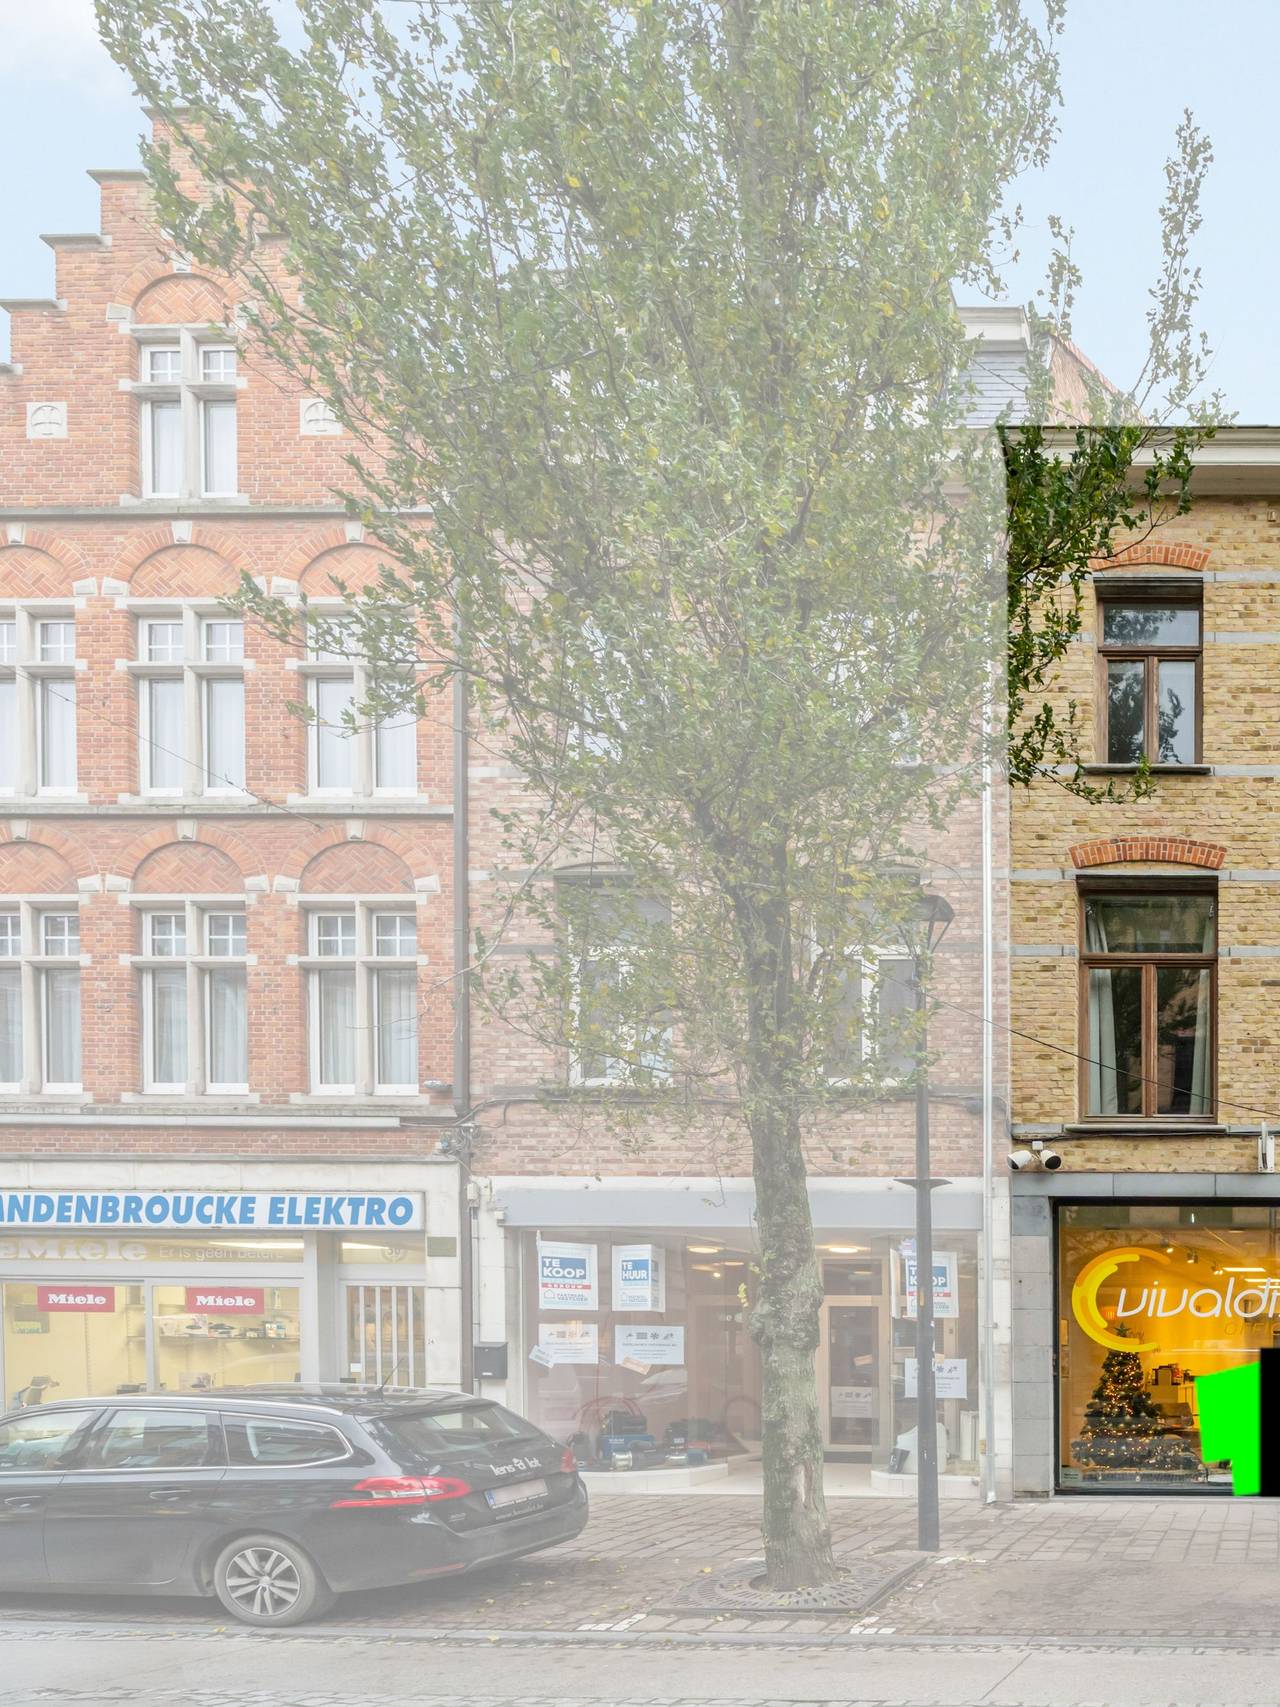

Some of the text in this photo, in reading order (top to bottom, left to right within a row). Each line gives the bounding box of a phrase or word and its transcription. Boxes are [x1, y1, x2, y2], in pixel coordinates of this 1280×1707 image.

[0, 1195, 414, 1226] NDENBROUCKE ELEKTRO
[18, 1239, 147, 1261] Miele
[195, 1248, 233, 1262] geen
[543, 1257, 561, 1268] TE
[621, 1261, 633, 1271] TE
[543, 1268, 585, 1278] KOOP
[621, 1270, 648, 1280] HUUR
[47, 1293, 107, 1306] Miele
[195, 1295, 256, 1307] Miele
[490, 1464, 515, 1476] lens
